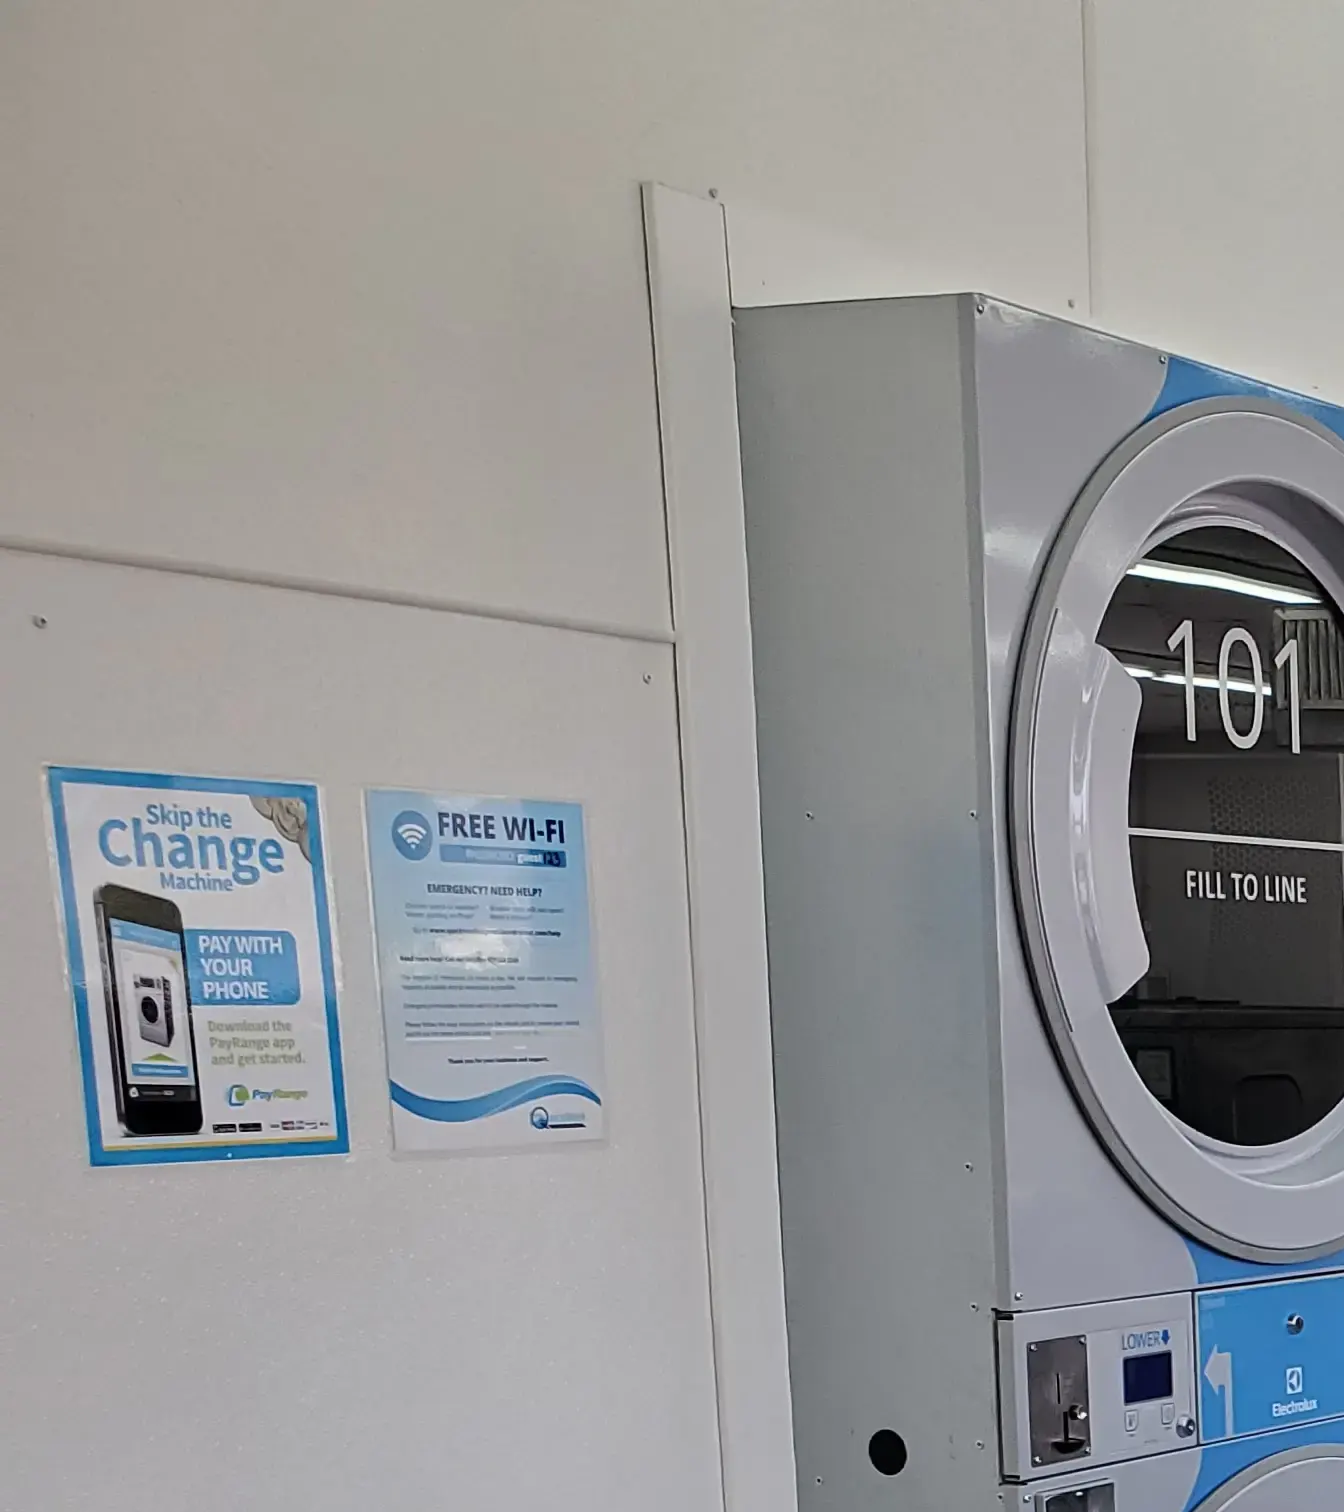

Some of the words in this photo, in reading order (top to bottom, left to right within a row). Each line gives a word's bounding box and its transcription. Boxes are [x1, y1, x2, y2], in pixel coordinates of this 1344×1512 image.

[1167, 619, 1301, 755] 101
[146, 803, 193, 831] Skip
[196, 806, 232, 829] the
[438, 812, 496, 840] FREE
[502, 816, 566, 844] WI-FI
[98, 817, 285, 886] Change
[160, 872, 234, 892] Machine
[427, 883, 488, 896] EMERGENCY?
[490, 886, 514, 897] NEED
[516, 886, 543, 897] HELP?
[1186, 870, 1226, 900] FILL
[1230, 872, 1259, 901] TO
[1264, 875, 1307, 903] LINE
[198, 935, 236, 954] PAY
[235, 936, 284, 955] WITH
[201, 958, 254, 977] YOUR
[203, 981, 270, 1000] PHONE
[208, 1020, 270, 1032] Download
[272, 1020, 292, 1032] the
[209, 1037, 270, 1051] PayRange
[272, 1038, 295, 1051] app
[211, 1054, 235, 1065] and
[237, 1055, 257, 1067] get
[259, 1053, 306, 1065] started.
[252, 1089, 308, 1102] PayRange
[1121, 1330, 1161, 1351] LOWER
[1272, 1398, 1318, 1418] Electrolux
